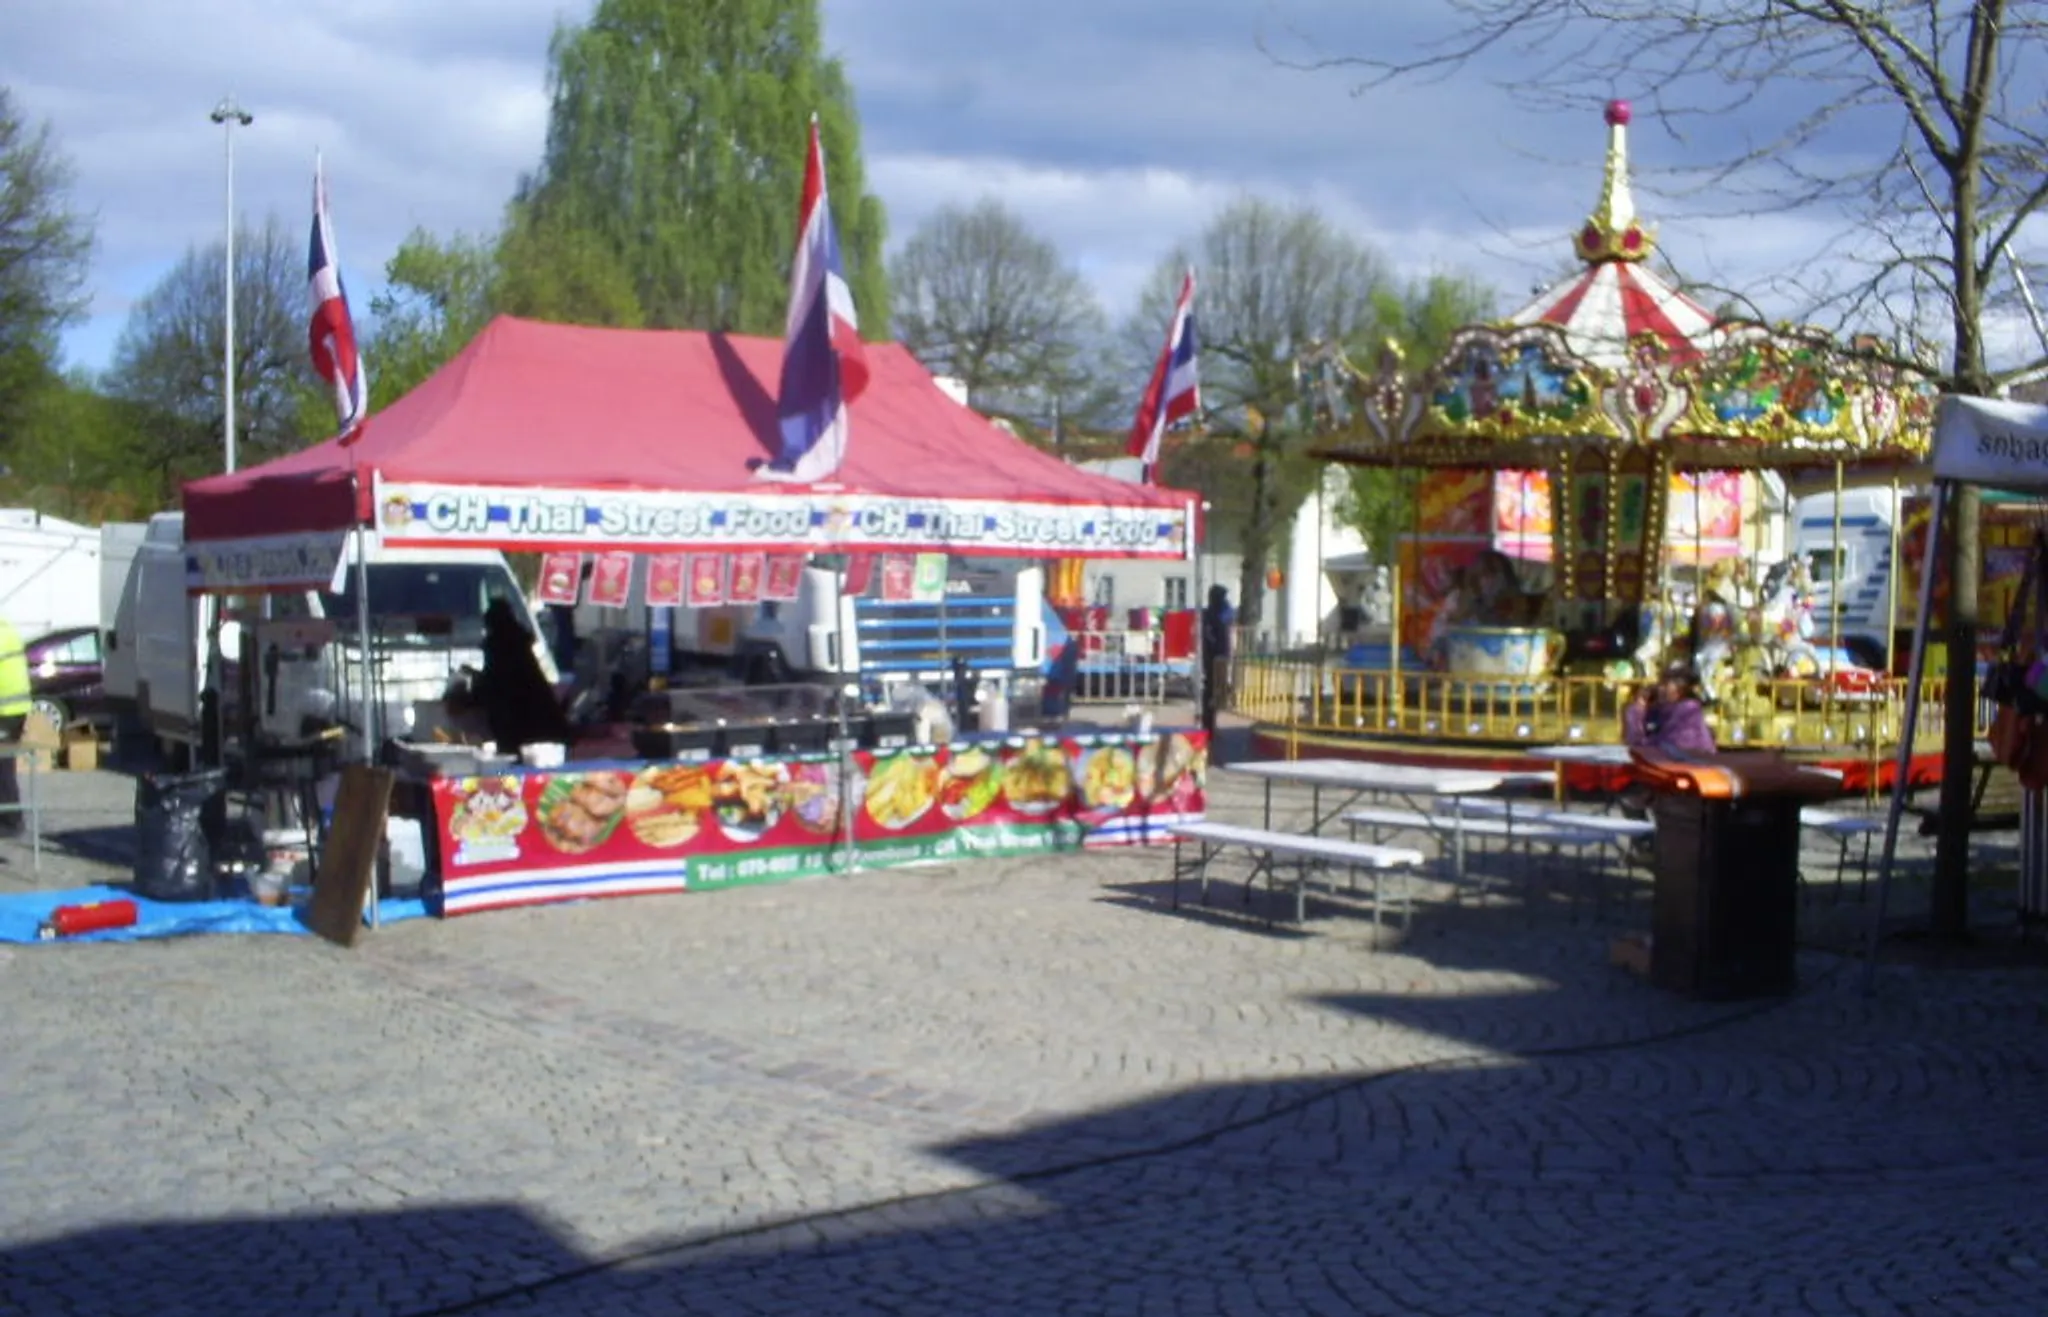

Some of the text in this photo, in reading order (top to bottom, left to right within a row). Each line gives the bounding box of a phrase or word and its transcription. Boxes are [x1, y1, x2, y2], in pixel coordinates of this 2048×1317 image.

[426, 494, 812, 536] CH Thai Street Food
[861, 507, 1158, 545] CH Thai Street Food
